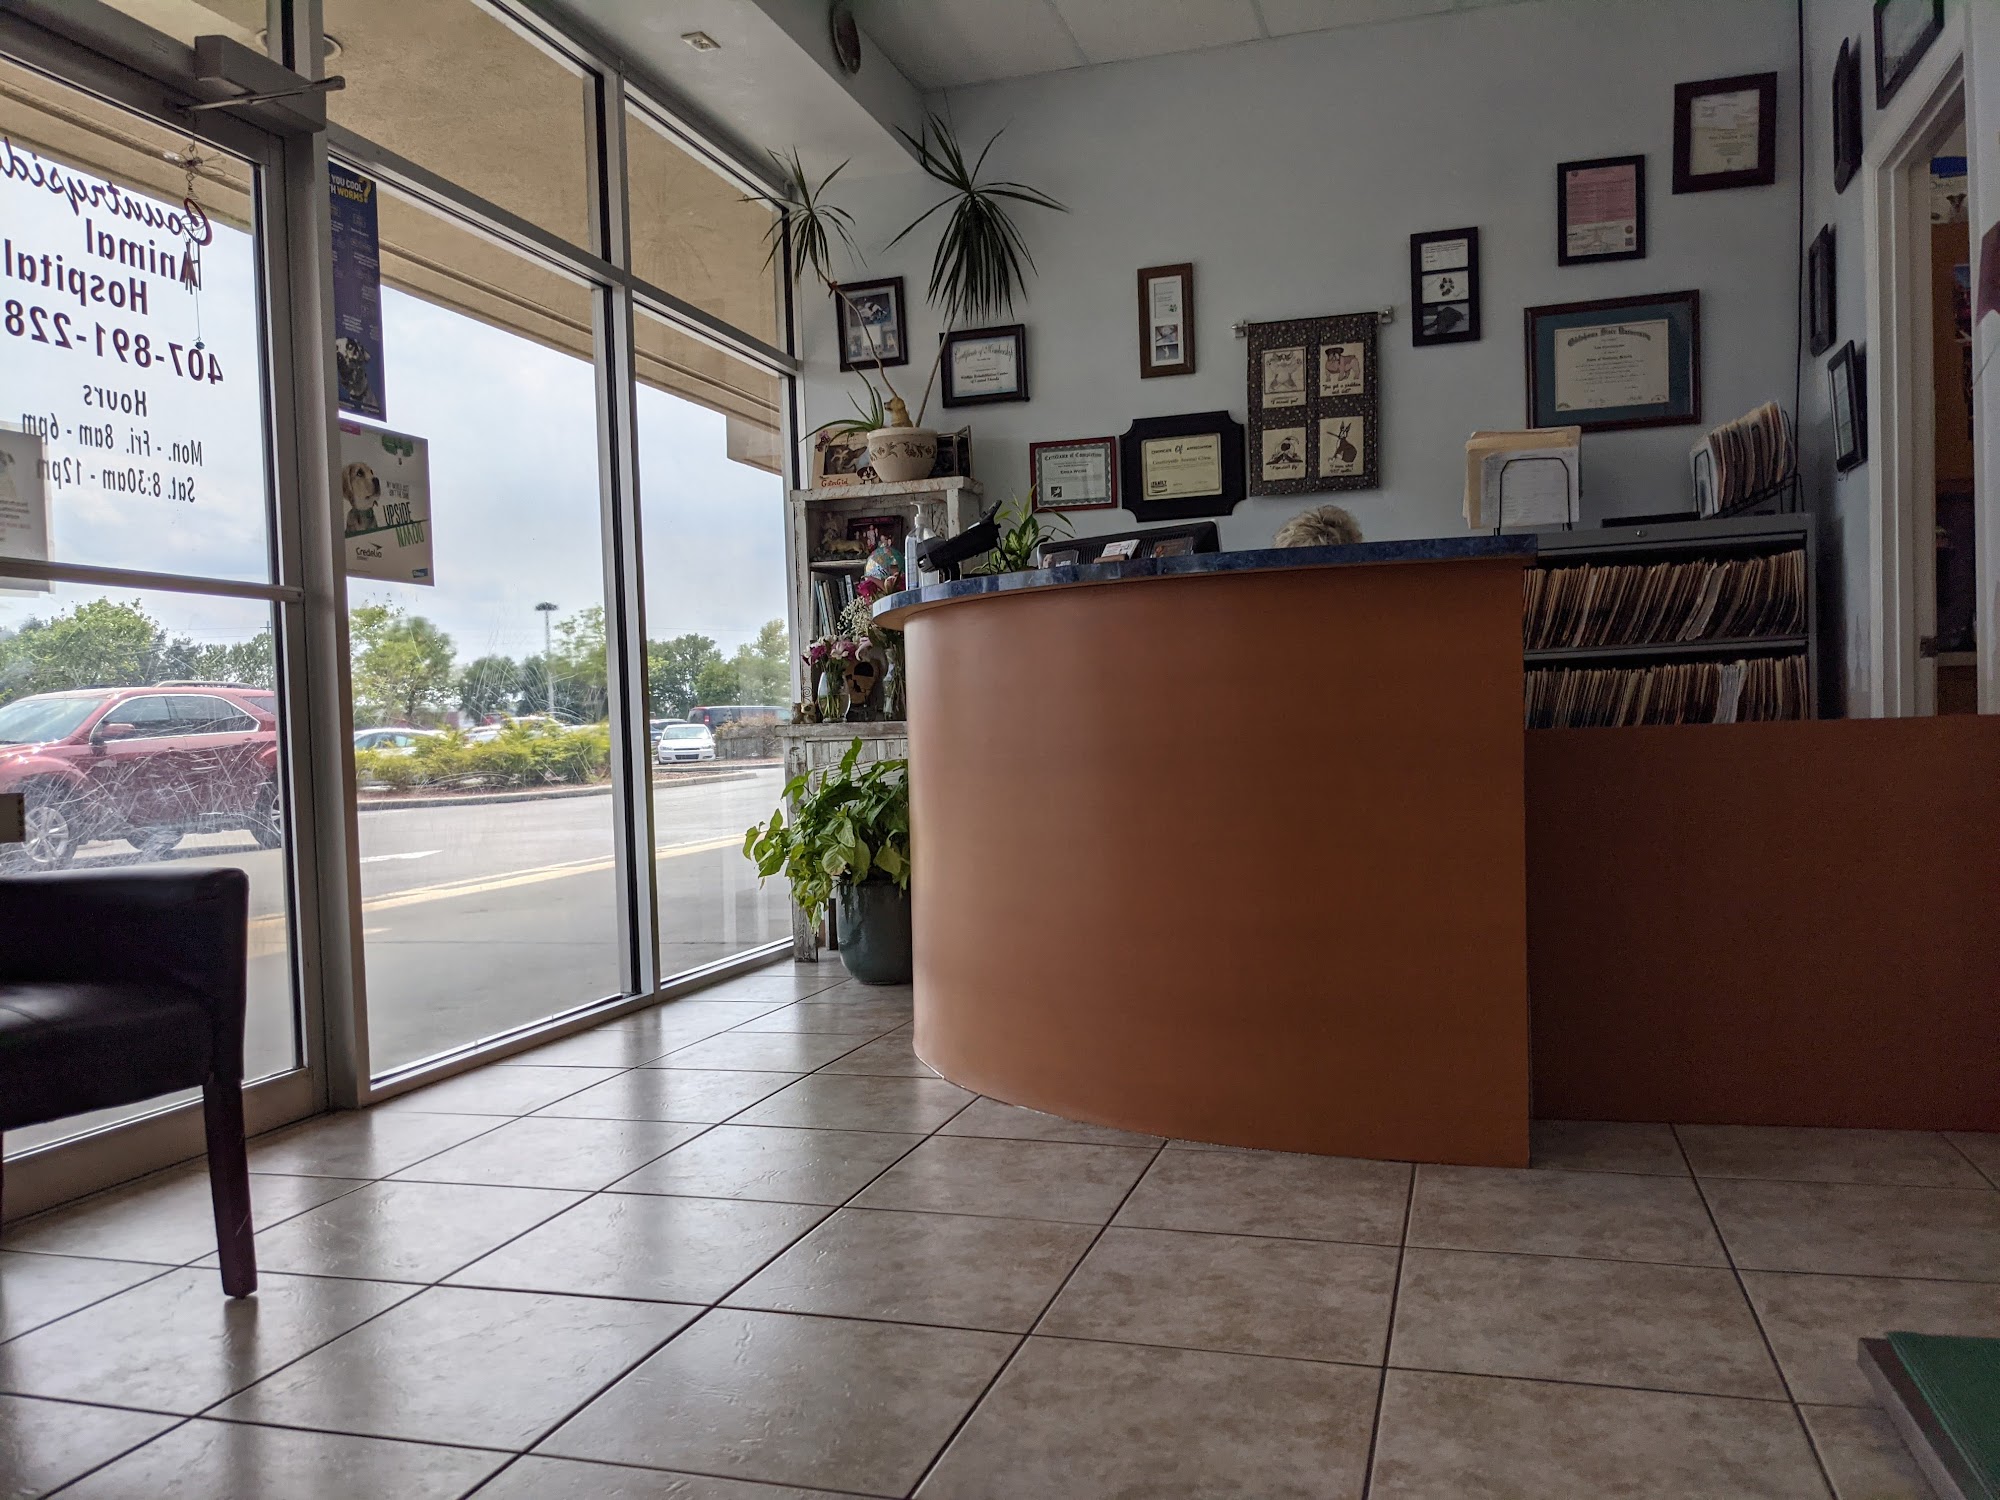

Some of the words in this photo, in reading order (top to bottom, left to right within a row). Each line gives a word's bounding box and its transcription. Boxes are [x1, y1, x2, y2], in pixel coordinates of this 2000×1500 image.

[331, 173, 345, 186] YOU
[346, 179, 363, 192] COOL
[382, 502, 412, 526] UPSIDE
